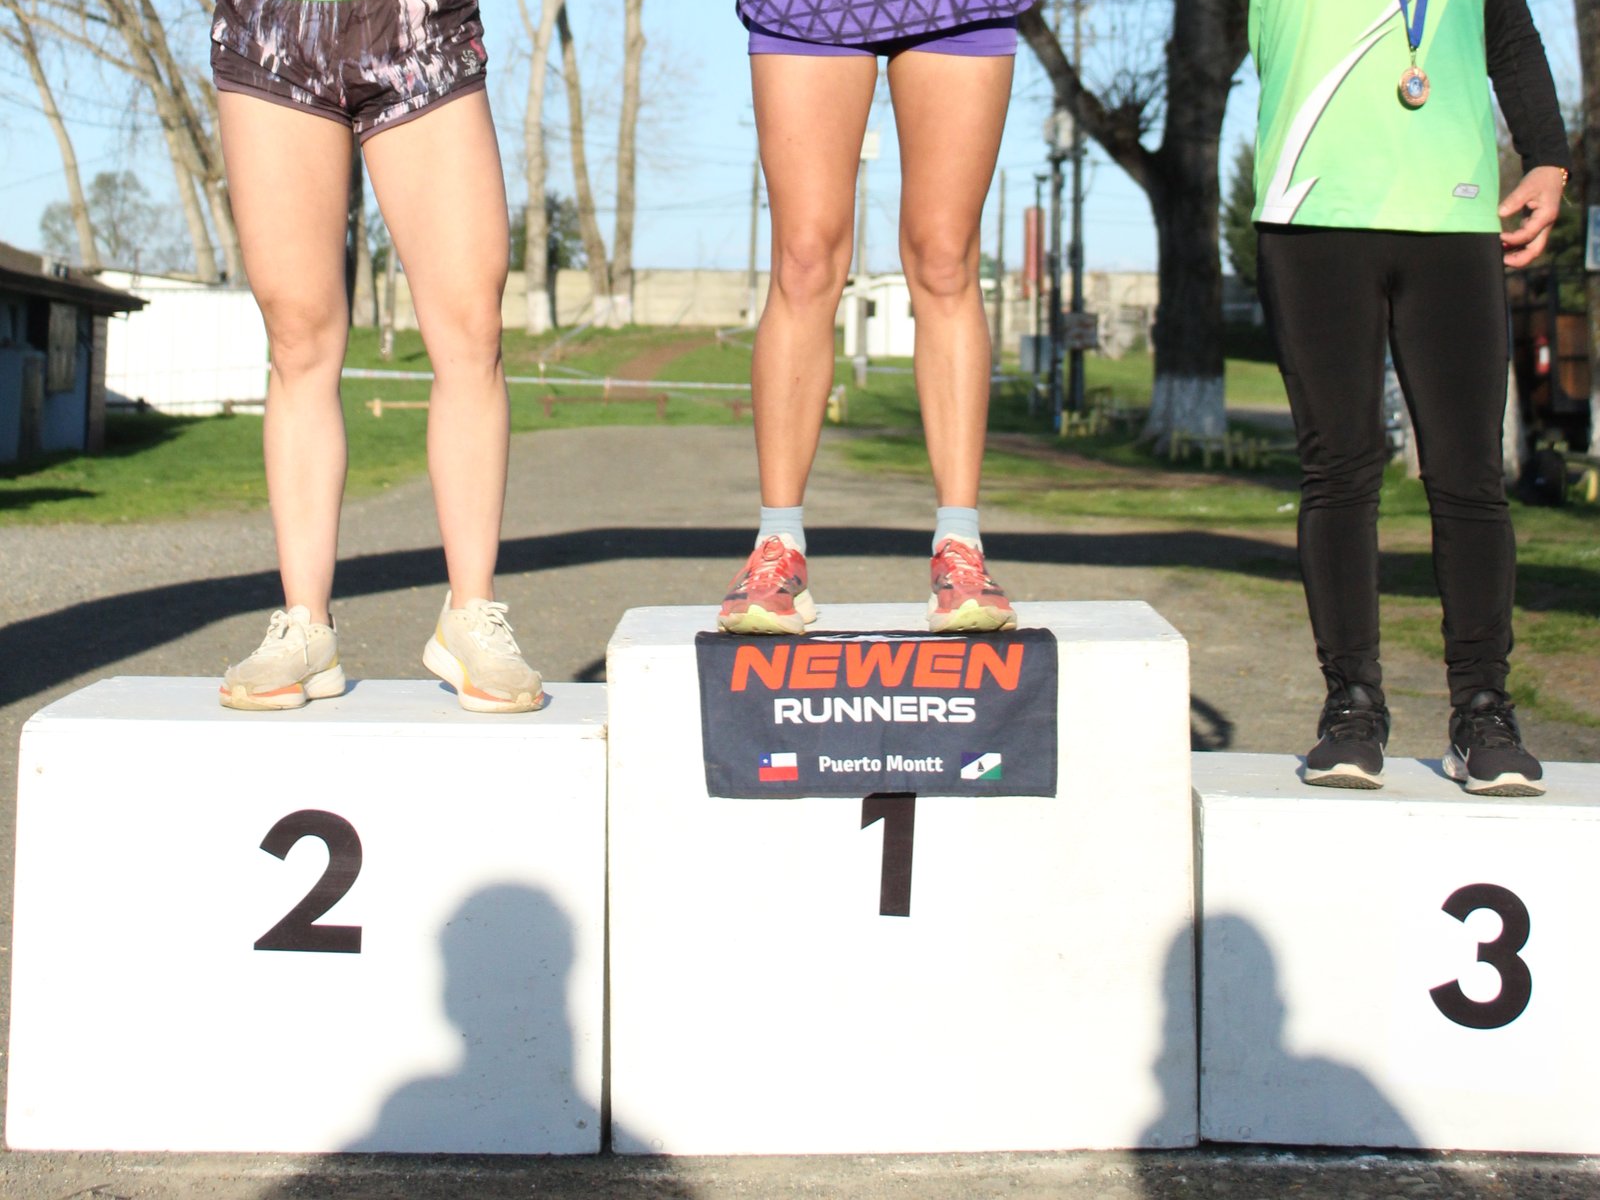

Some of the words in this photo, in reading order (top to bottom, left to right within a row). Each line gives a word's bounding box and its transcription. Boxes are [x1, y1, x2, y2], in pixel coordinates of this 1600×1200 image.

[731, 643, 1025, 692] NEWEN
[774, 696, 976, 724] RUNNERS
[818, 756, 882, 773] Puerto
[886, 755, 944, 773] Montt
[254, 809, 363, 954] 2
[861, 792, 917, 917] 1
[1429, 883, 1532, 1030] 3
